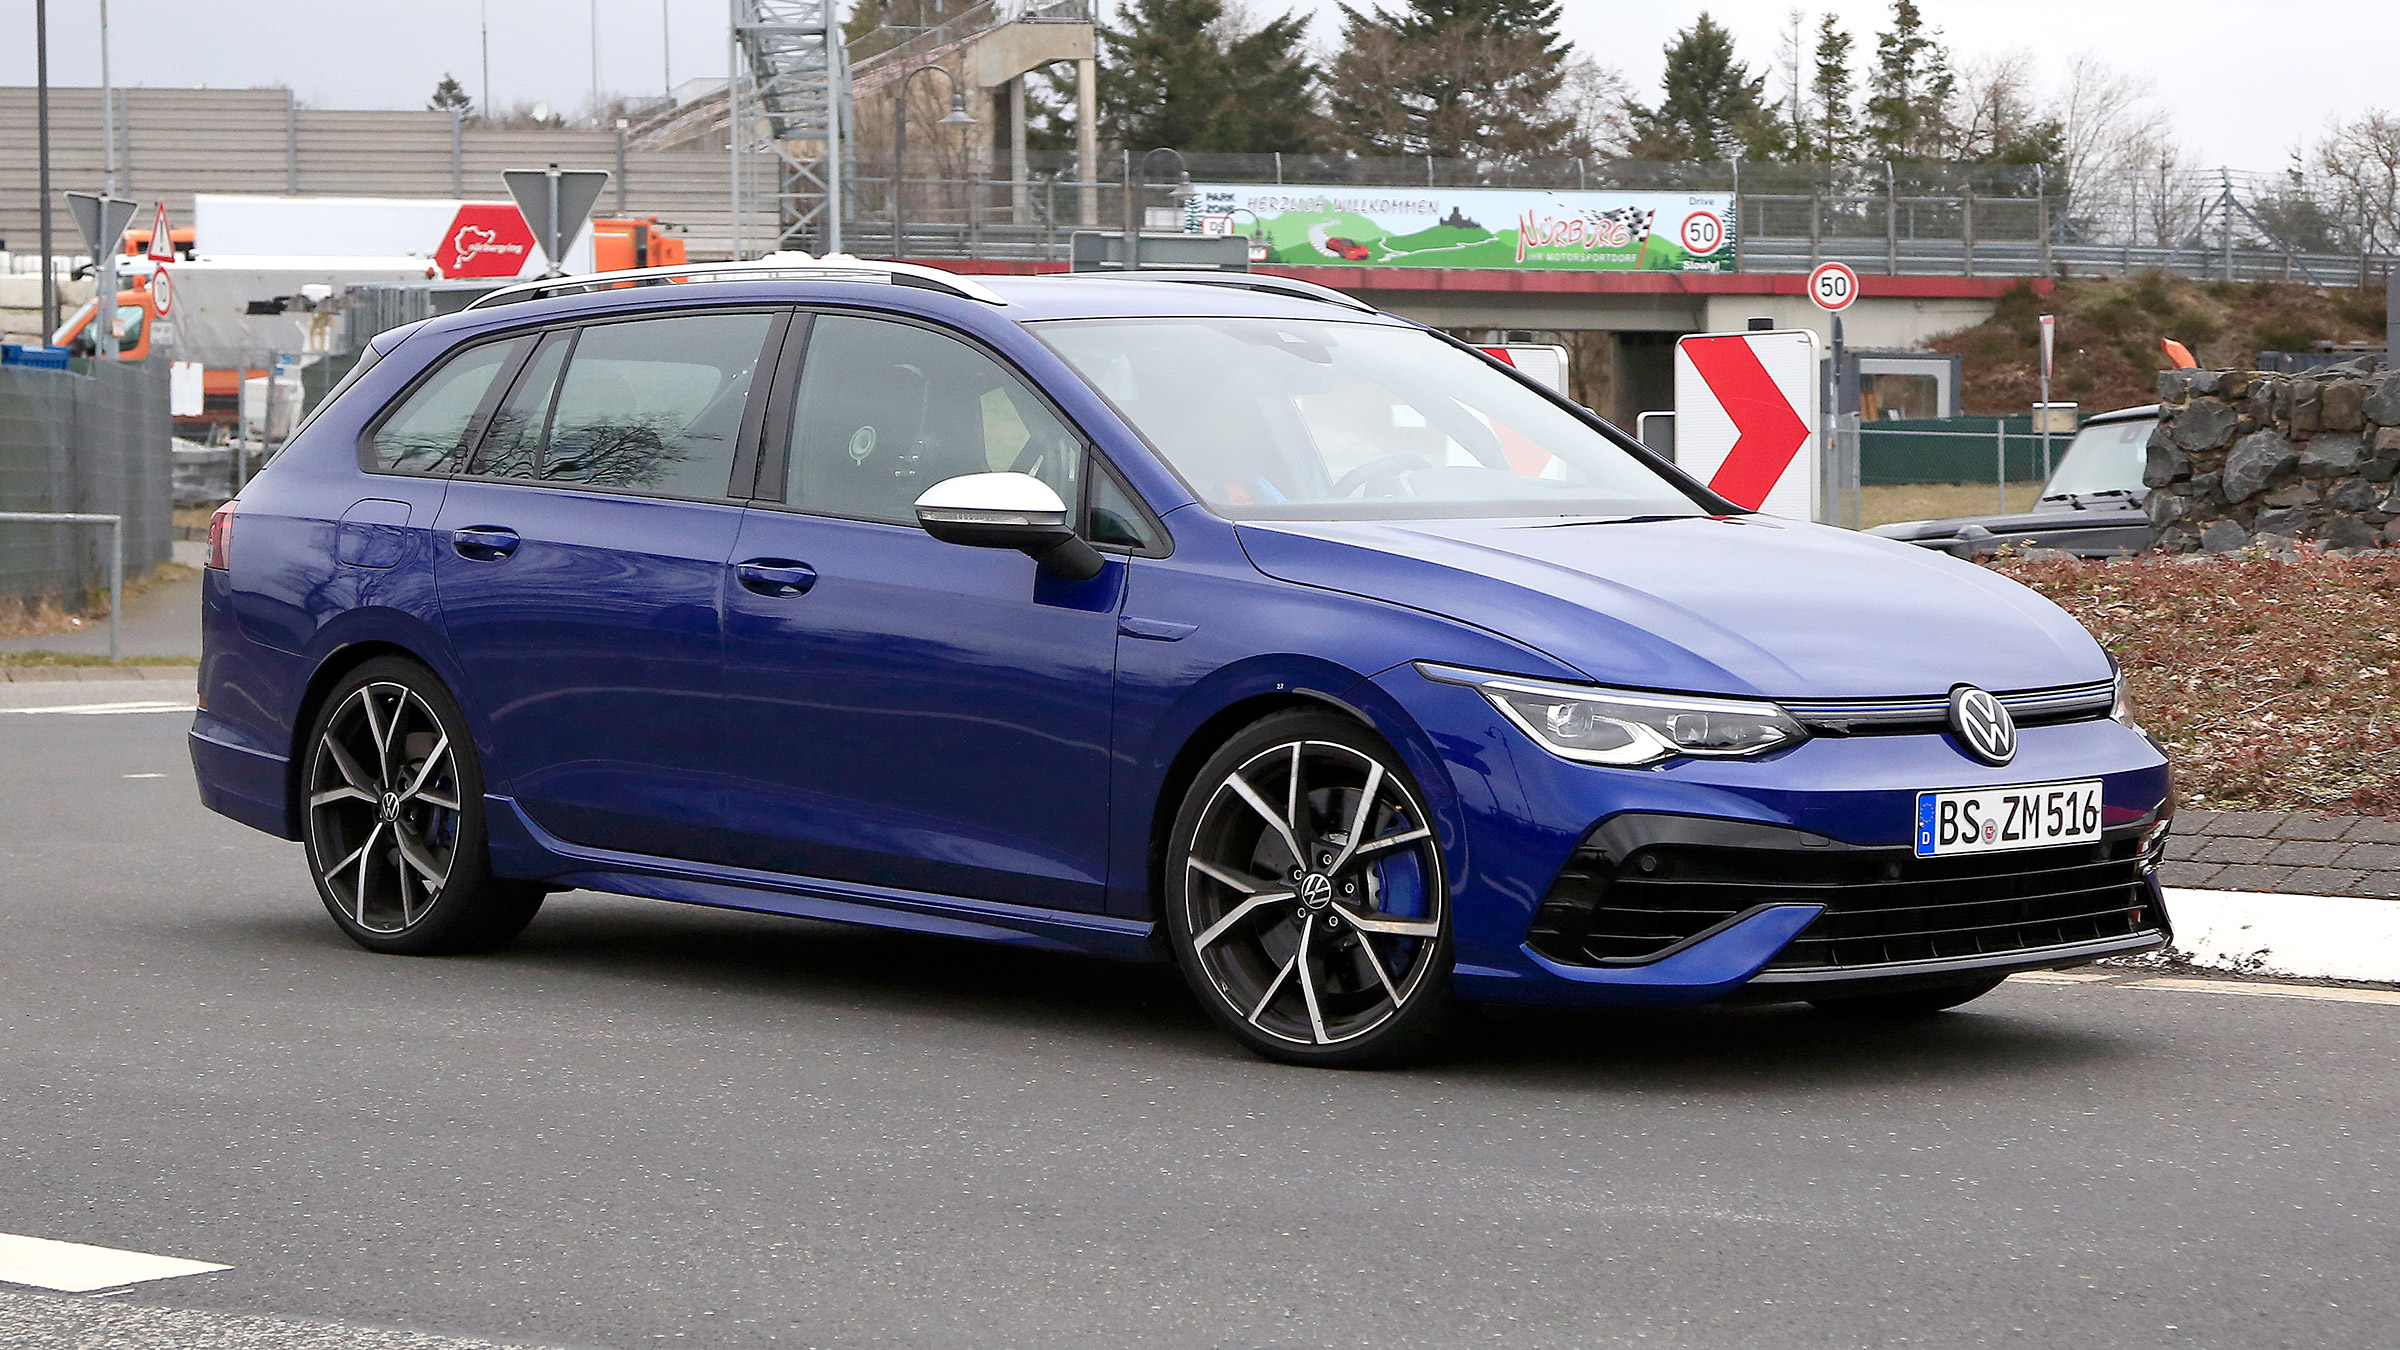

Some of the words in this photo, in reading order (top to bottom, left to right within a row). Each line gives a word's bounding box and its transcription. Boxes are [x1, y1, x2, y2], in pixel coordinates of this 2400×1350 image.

[1206, 192, 1235, 201] PARK
[1689, 196, 1715, 205] Drive
[1247, 196, 1326, 213] HERZLICH
[1333, 197, 1440, 215] WILLKOMMEN
[1516, 208, 1631, 263] NÜRBURG
[1690, 222, 1714, 242] 50
[1526, 253, 1543, 261] IHR
[1546, 253, 1637, 262] MOTORSPORTDORF
[1683, 260, 1720, 275] Slowly!
[1821, 276, 1846, 297] 50
[1939, 799, 1981, 846] BS
[2001, 794, 2040, 841] ZM
[2047, 790, 2100, 837] 516
[1922, 831, 1931, 845] D
